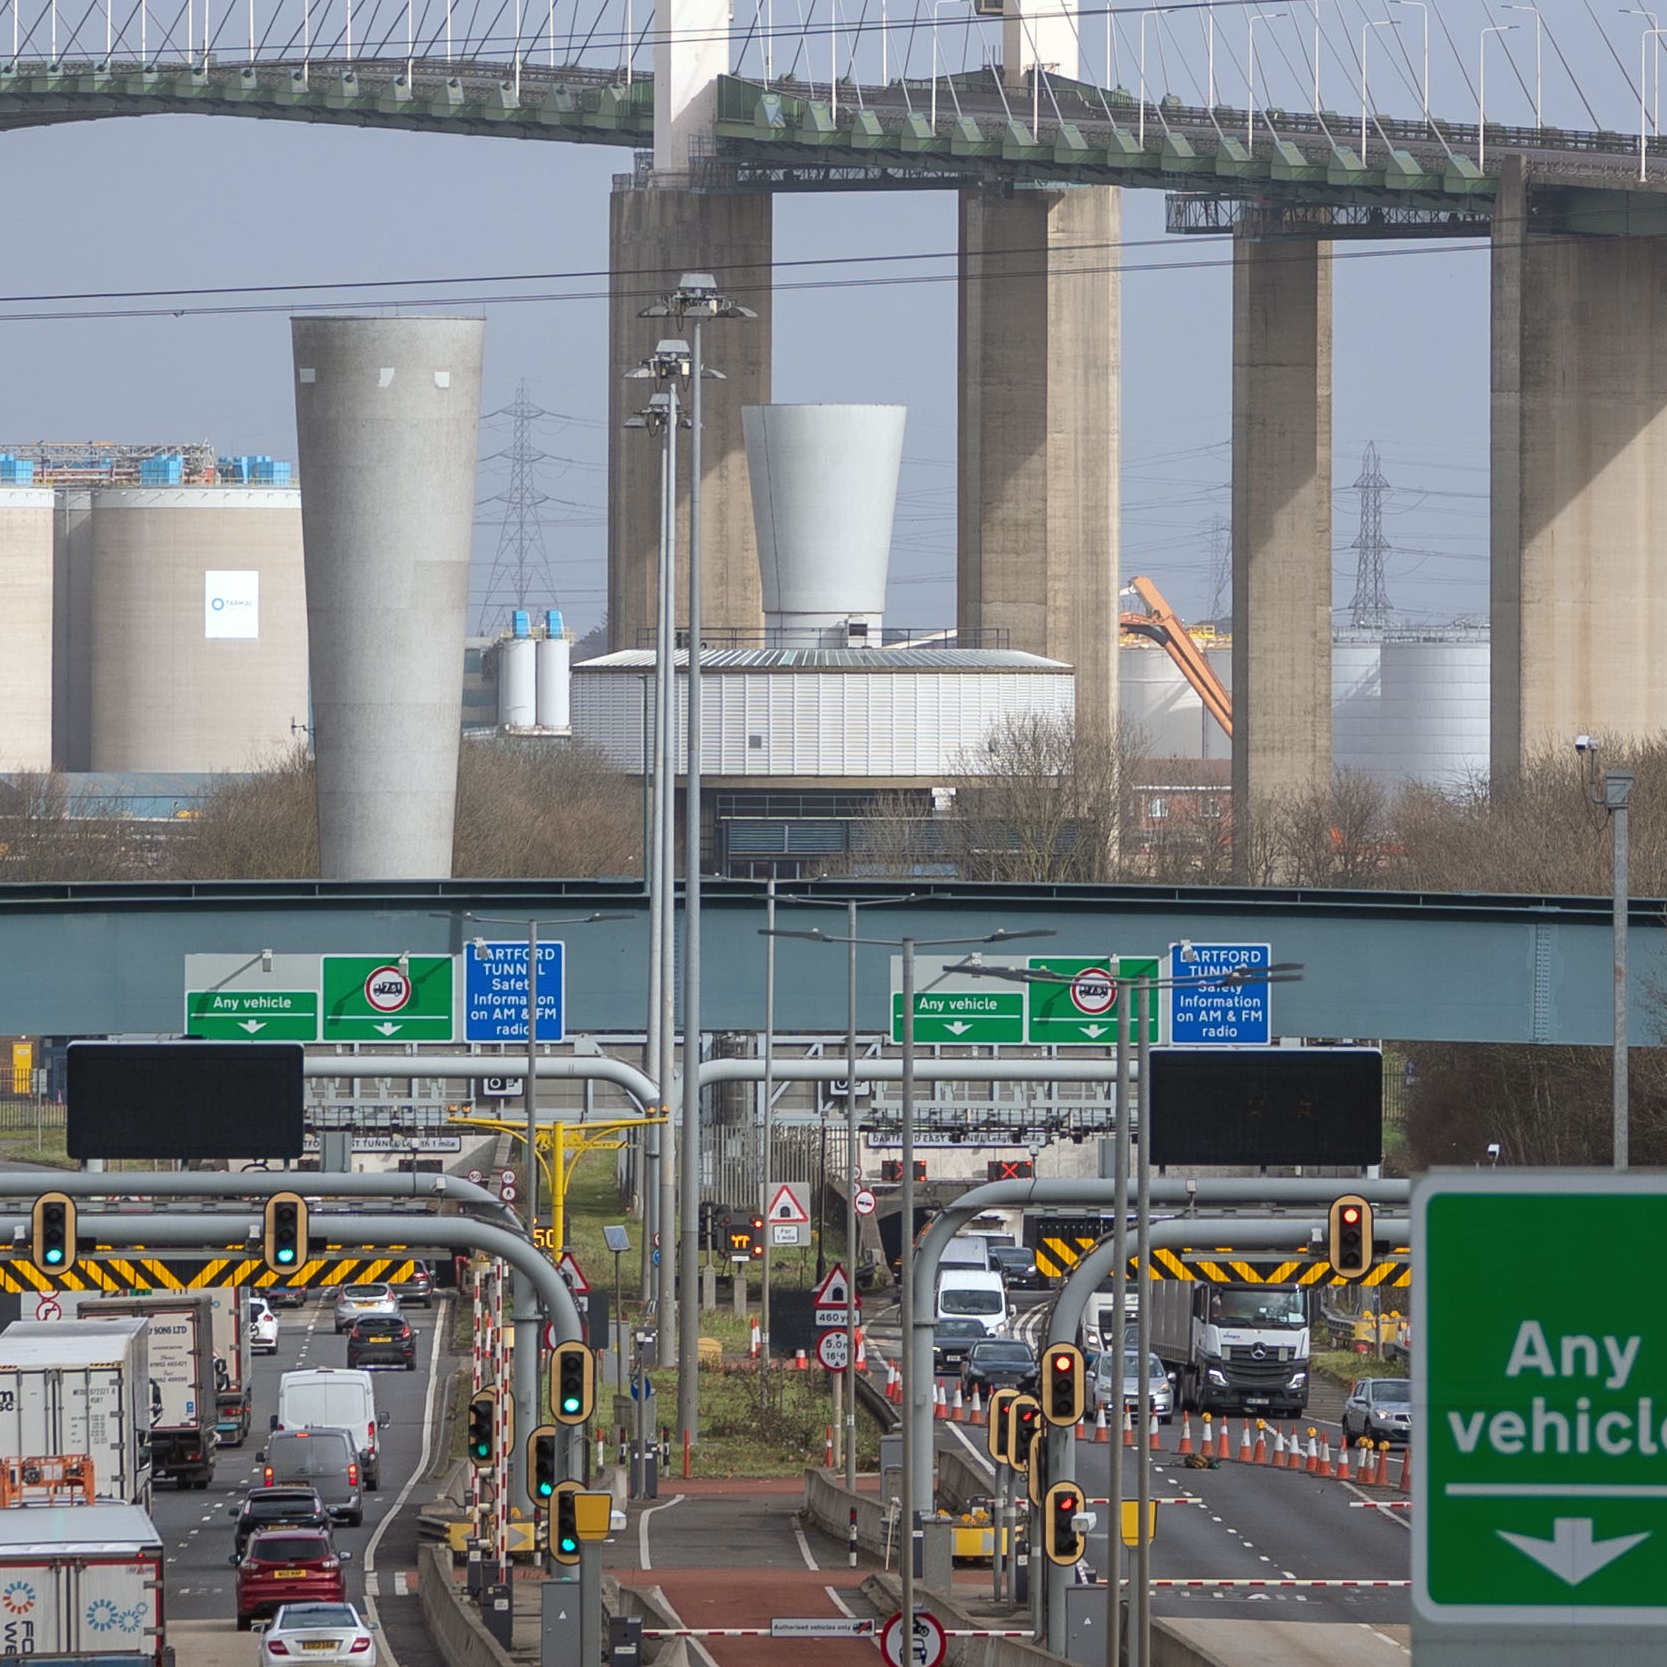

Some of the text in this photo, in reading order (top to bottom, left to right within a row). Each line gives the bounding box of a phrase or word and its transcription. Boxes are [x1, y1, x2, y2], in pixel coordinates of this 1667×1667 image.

[483, 963, 546, 975] TUNNL
[492, 978, 529, 990] Safet
[213, 996, 292, 1010] Any vehicle
[474, 994, 555, 1005] Informaon
[919, 997, 998, 1012] Any vehicle
[1180, 995, 1261, 1008] Information
[470, 1010, 488, 1020] on
[492, 1008, 515, 1020] AM
[536, 1008, 557, 1020] FM
[1176, 1010, 1263, 1022] on AM & FM
[1202, 1025, 1238, 1037] radio
[819, 1313, 839, 1322] 460
[1506, 1322, 1641, 1390] Any
